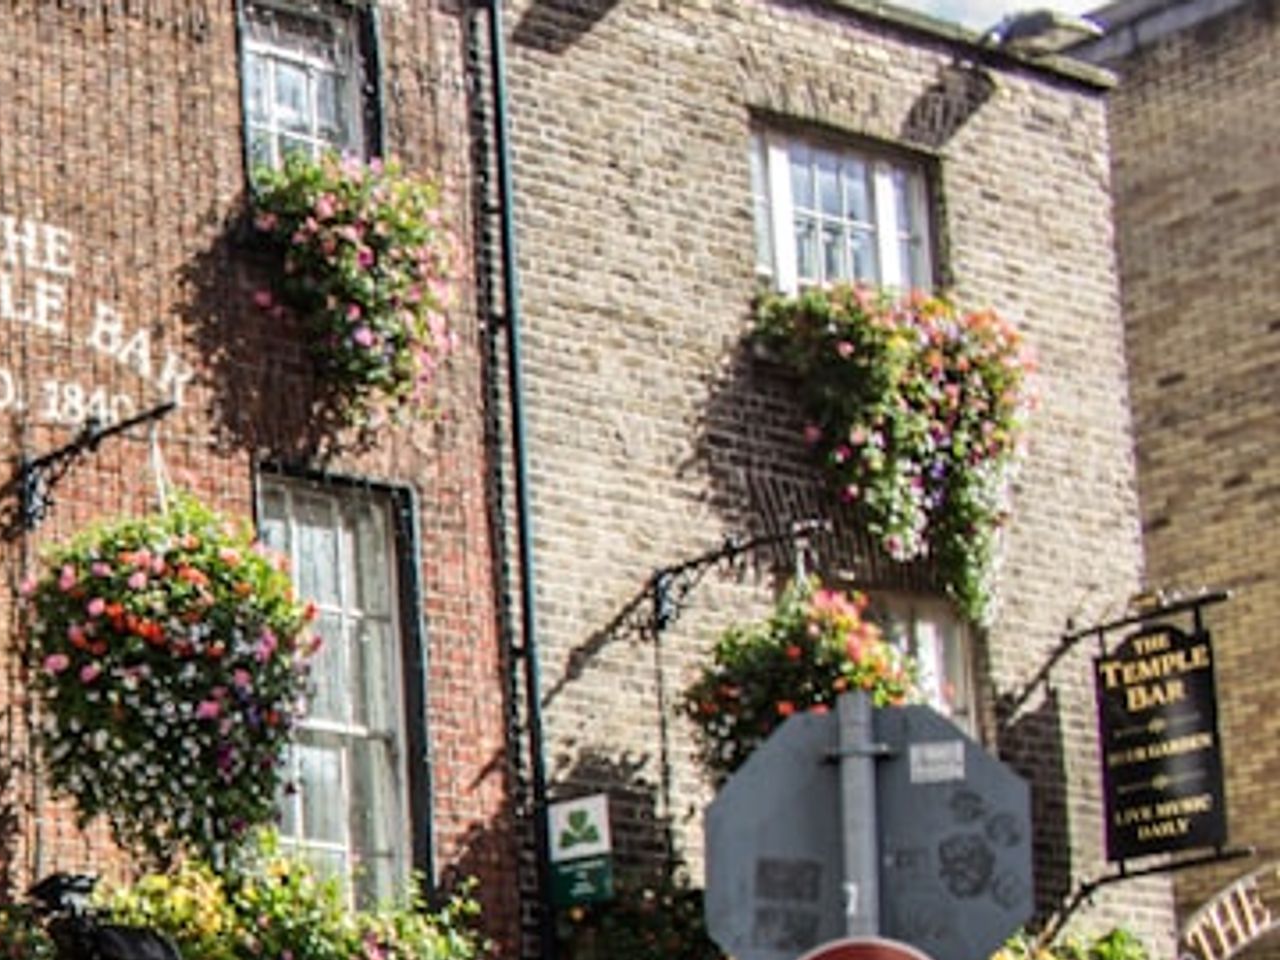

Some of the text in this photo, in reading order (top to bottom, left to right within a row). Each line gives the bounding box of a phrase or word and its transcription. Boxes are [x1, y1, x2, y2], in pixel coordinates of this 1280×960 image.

[89, 300, 193, 406] BAR
[1134, 632, 1171, 656] THE
[1099, 645, 1210, 689] TEMPLE
[1126, 679, 1185, 713] BAR
